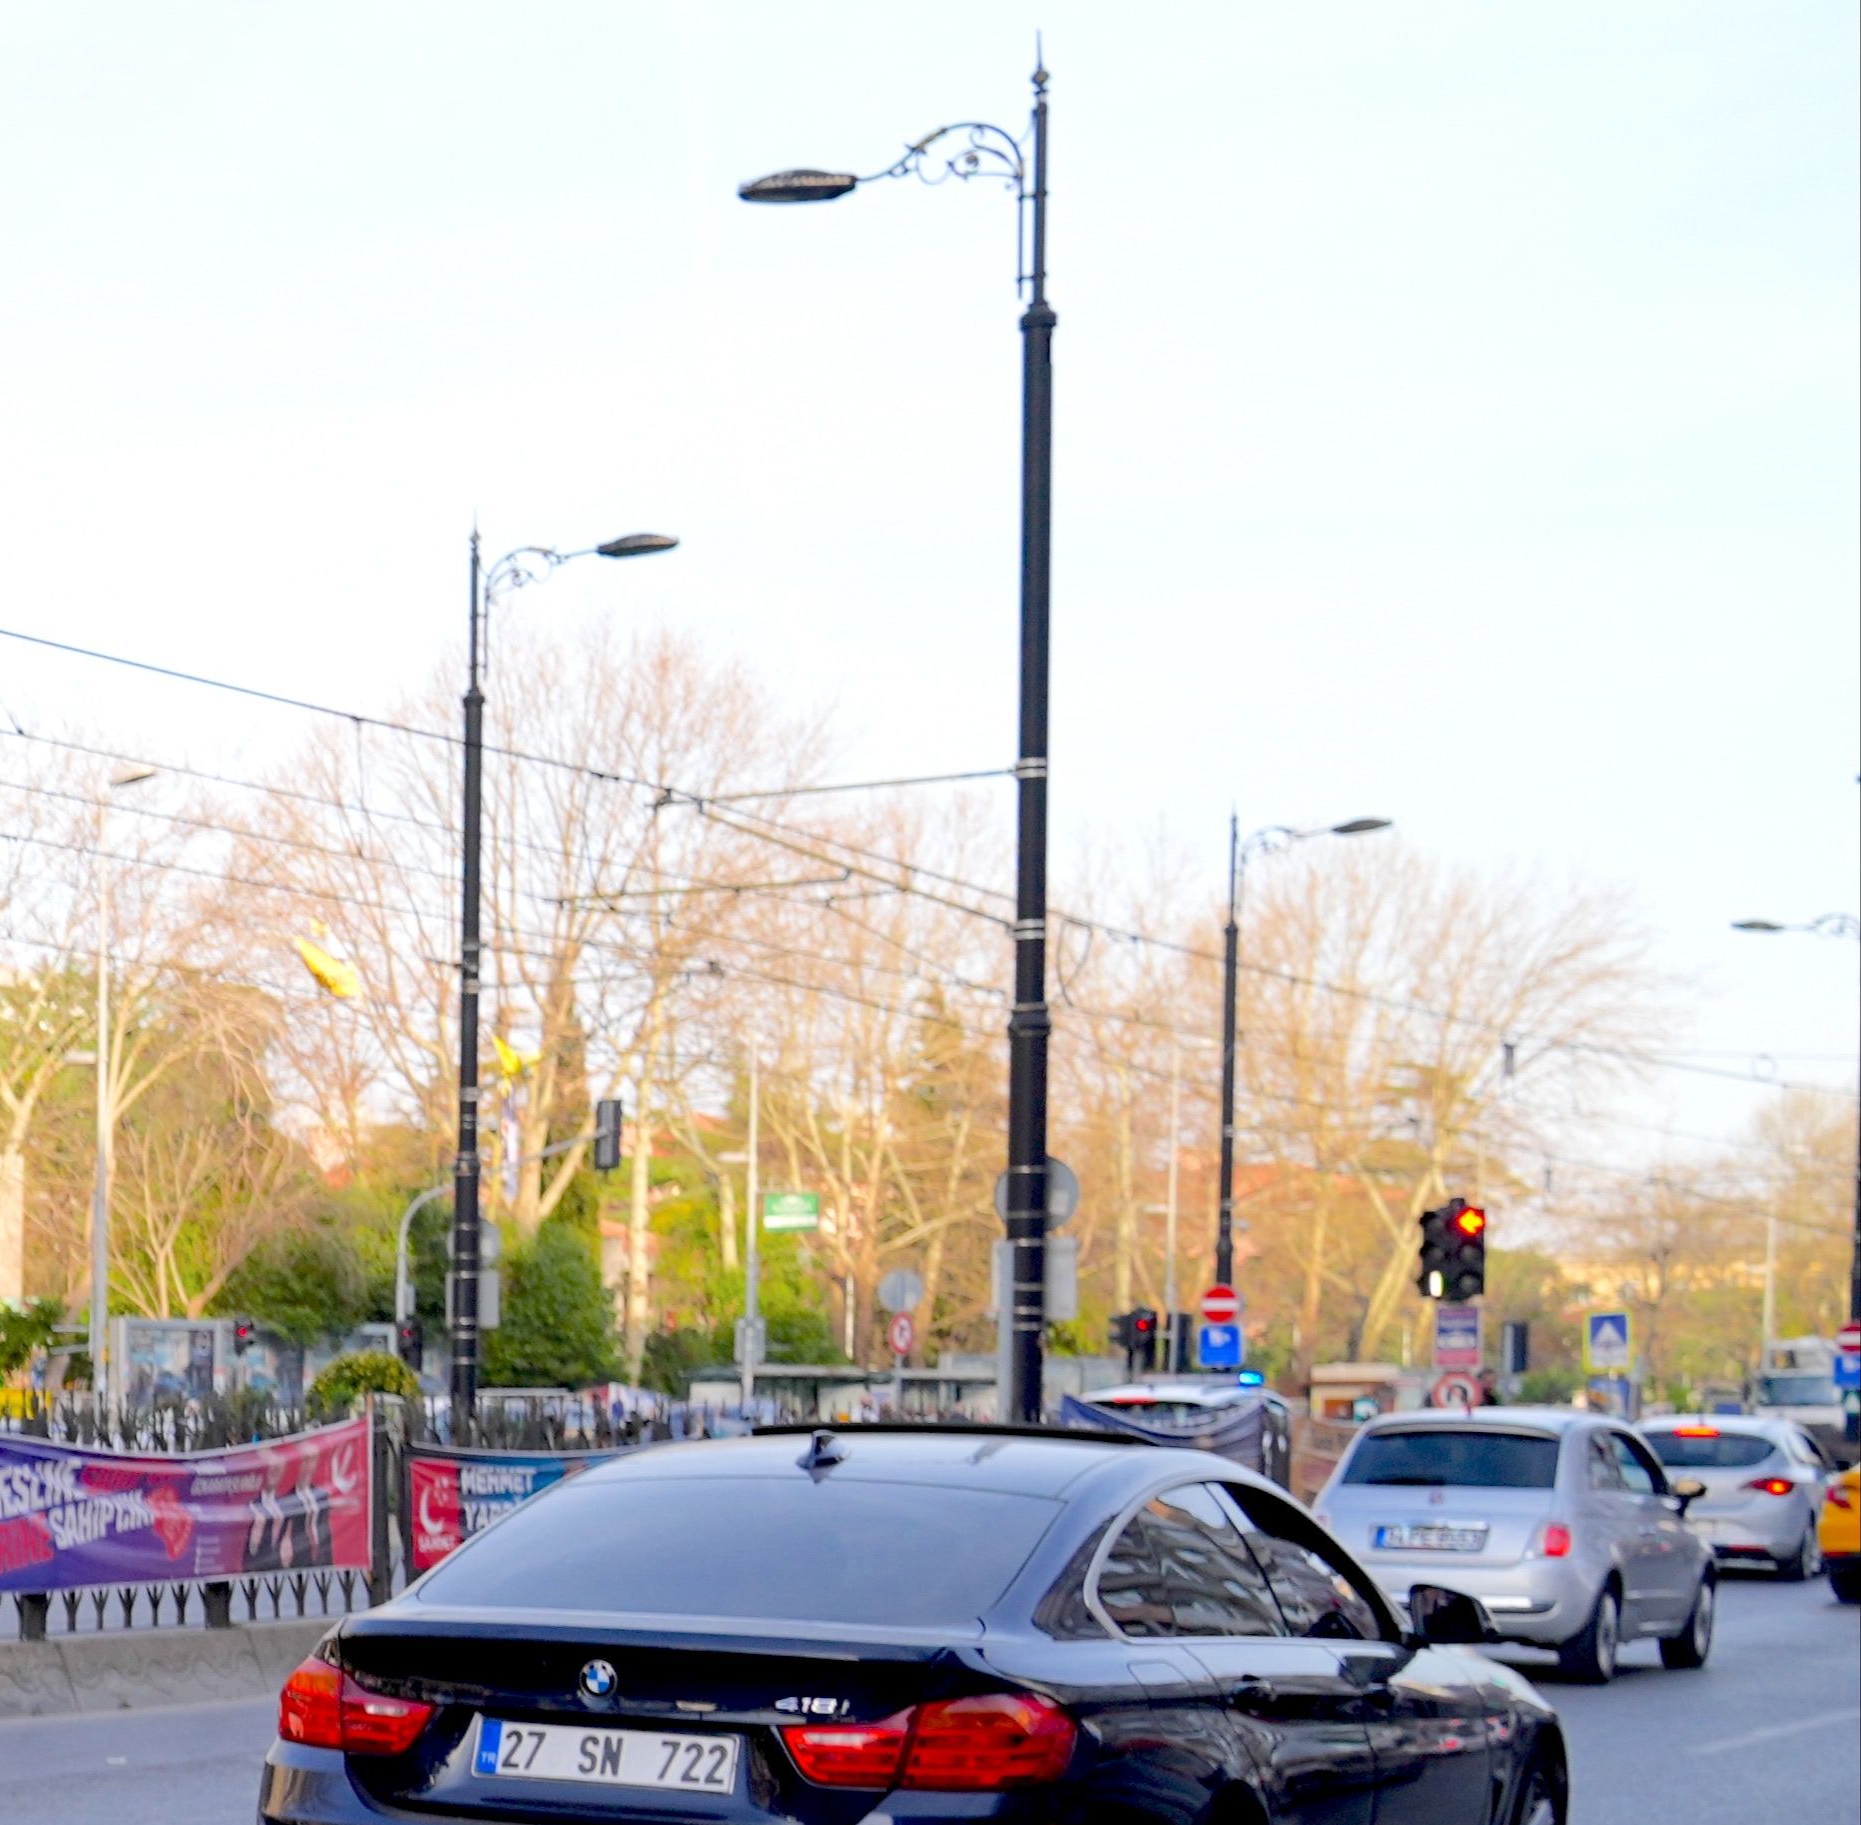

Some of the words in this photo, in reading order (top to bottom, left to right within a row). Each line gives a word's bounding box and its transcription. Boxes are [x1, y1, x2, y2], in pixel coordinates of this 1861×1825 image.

[501, 1730, 547, 1770] 27
[578, 1735, 624, 1777] SN
[657, 1740, 728, 1785] 722
